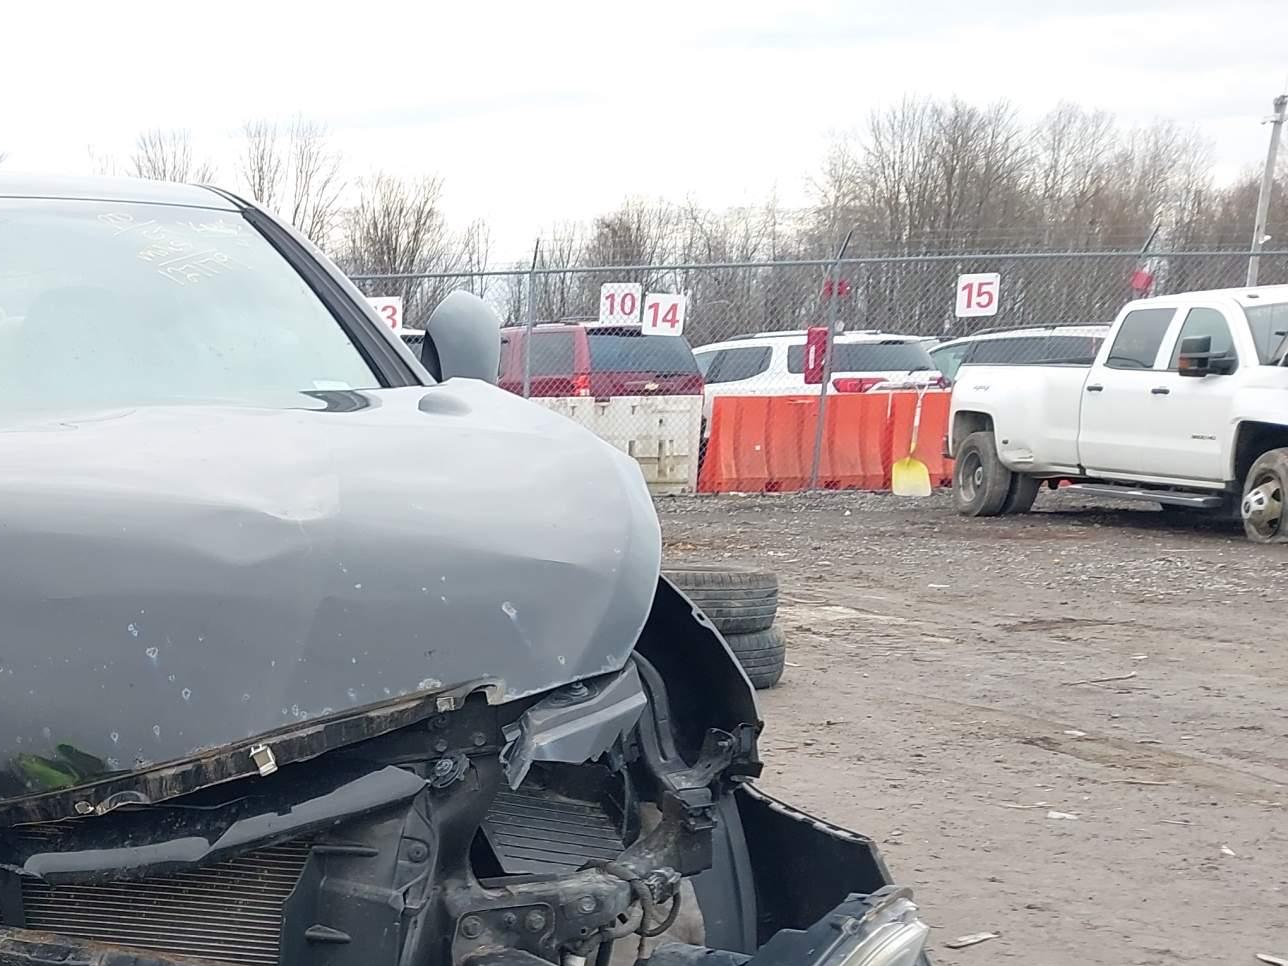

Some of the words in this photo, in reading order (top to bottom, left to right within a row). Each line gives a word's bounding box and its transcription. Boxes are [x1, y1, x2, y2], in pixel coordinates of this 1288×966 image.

[605, 292, 636, 316] 10
[961, 282, 994, 309] 15
[373, 304, 397, 329] 3
[648, 302, 680, 328] 14
